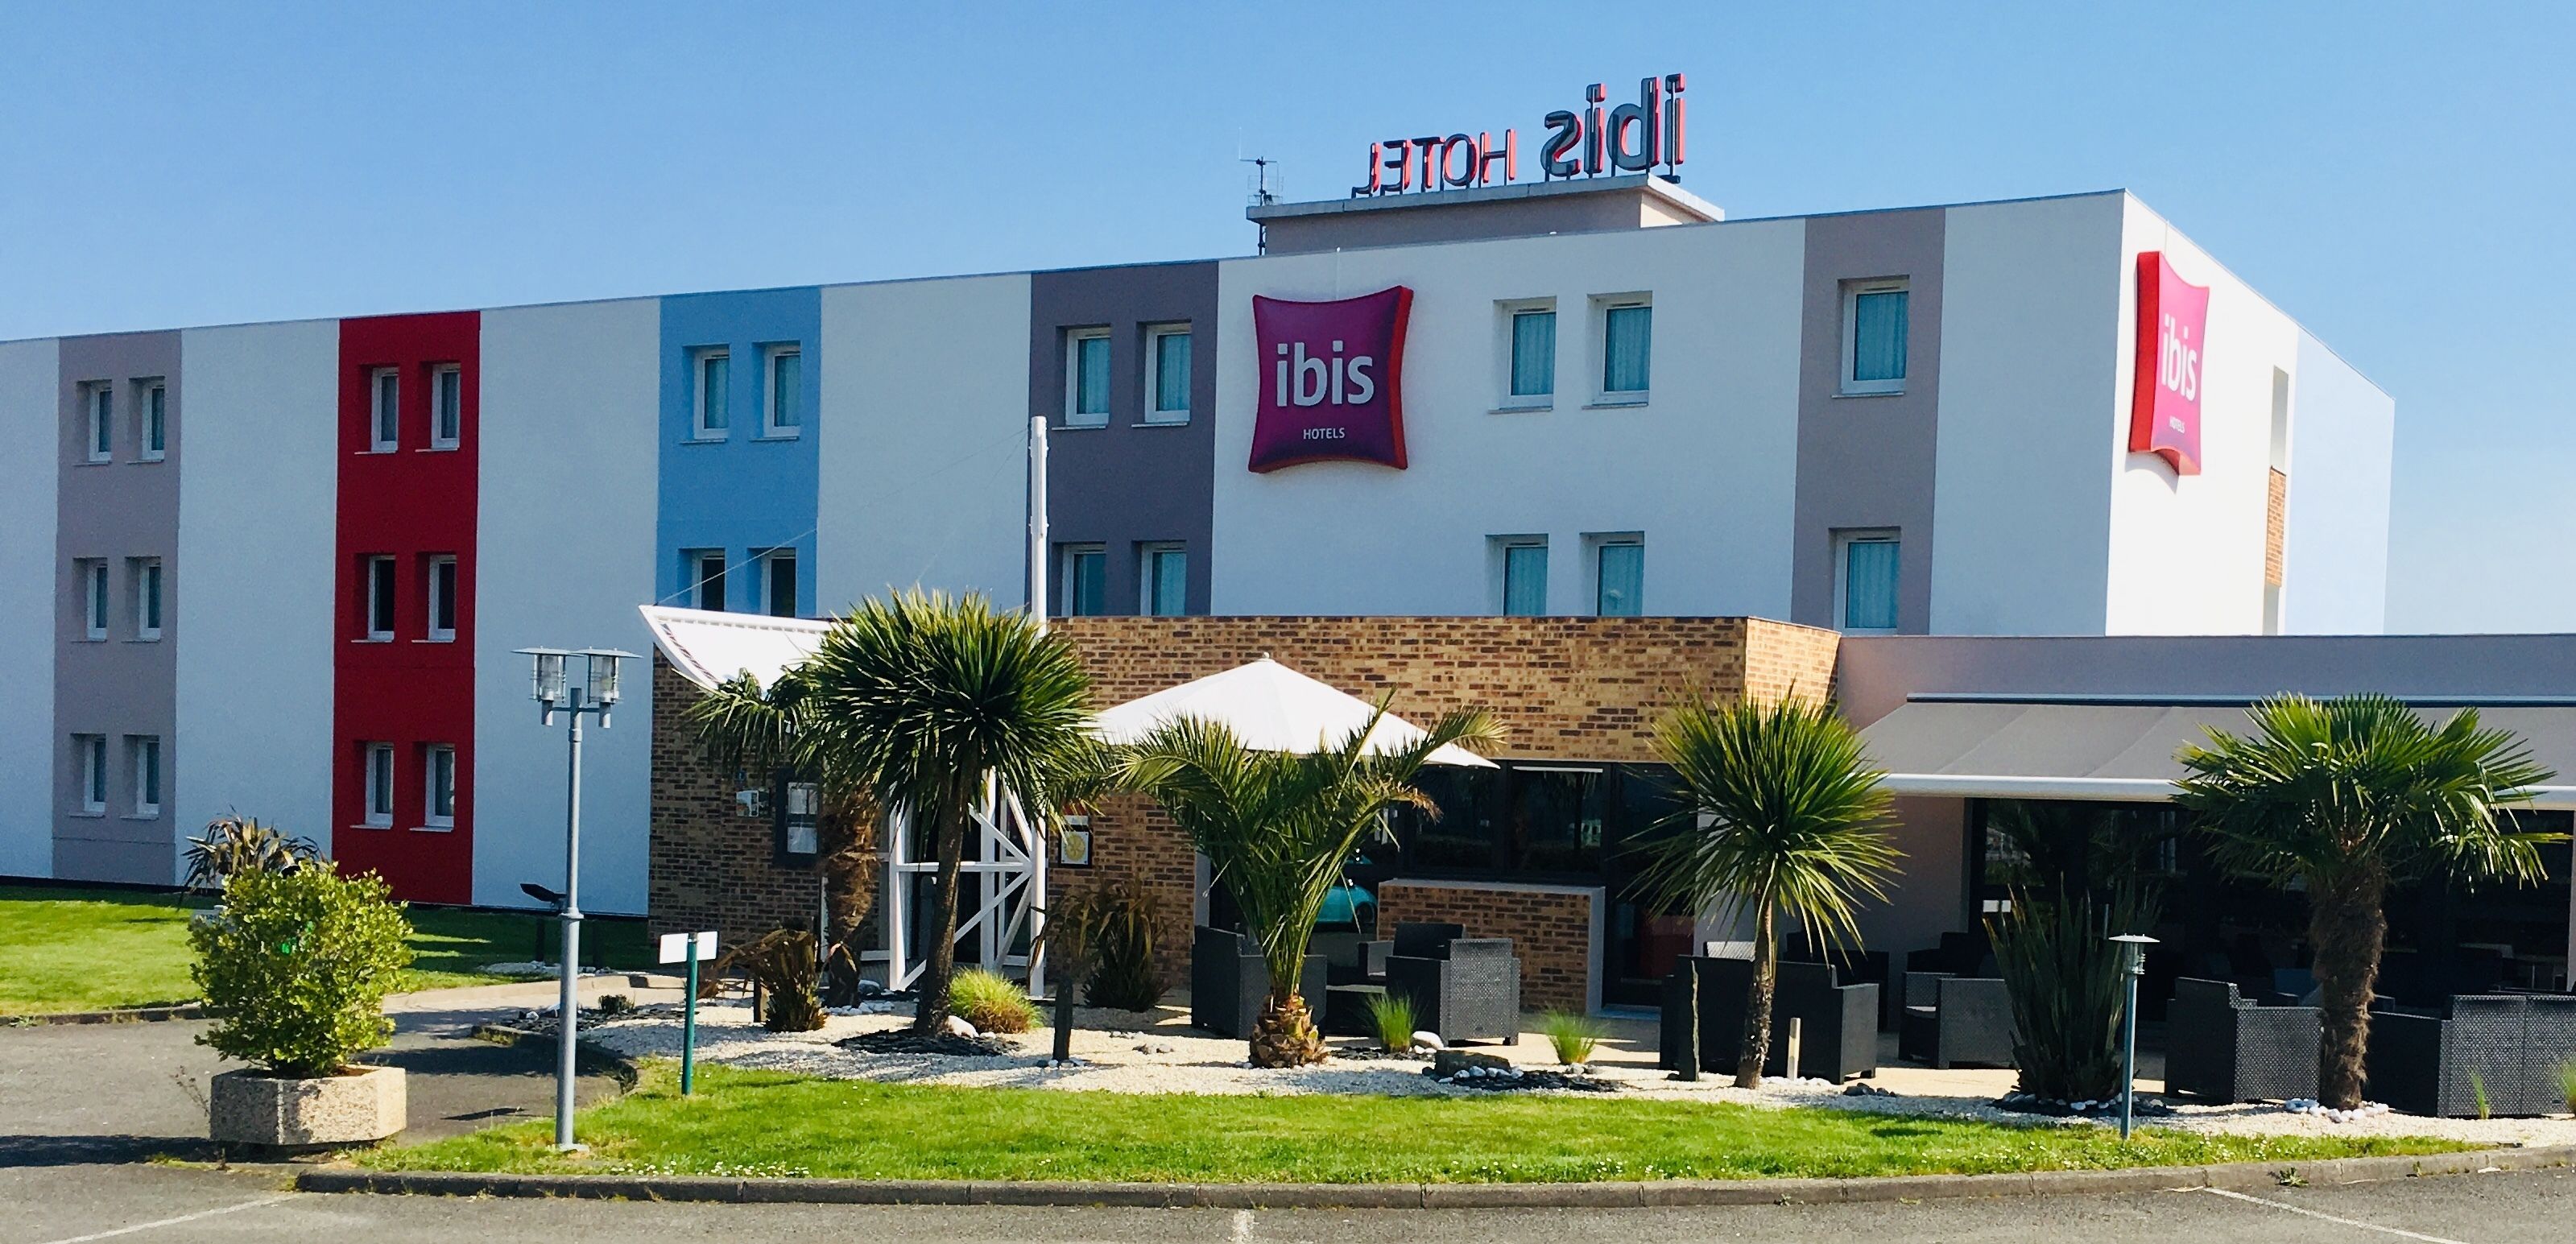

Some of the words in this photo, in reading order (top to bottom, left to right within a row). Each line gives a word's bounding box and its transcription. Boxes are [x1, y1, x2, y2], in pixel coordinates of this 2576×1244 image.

[1276, 339, 1375, 407] ibis
[2161, 313, 2197, 401] ibis
[1303, 427, 1346, 440] HOTELS
